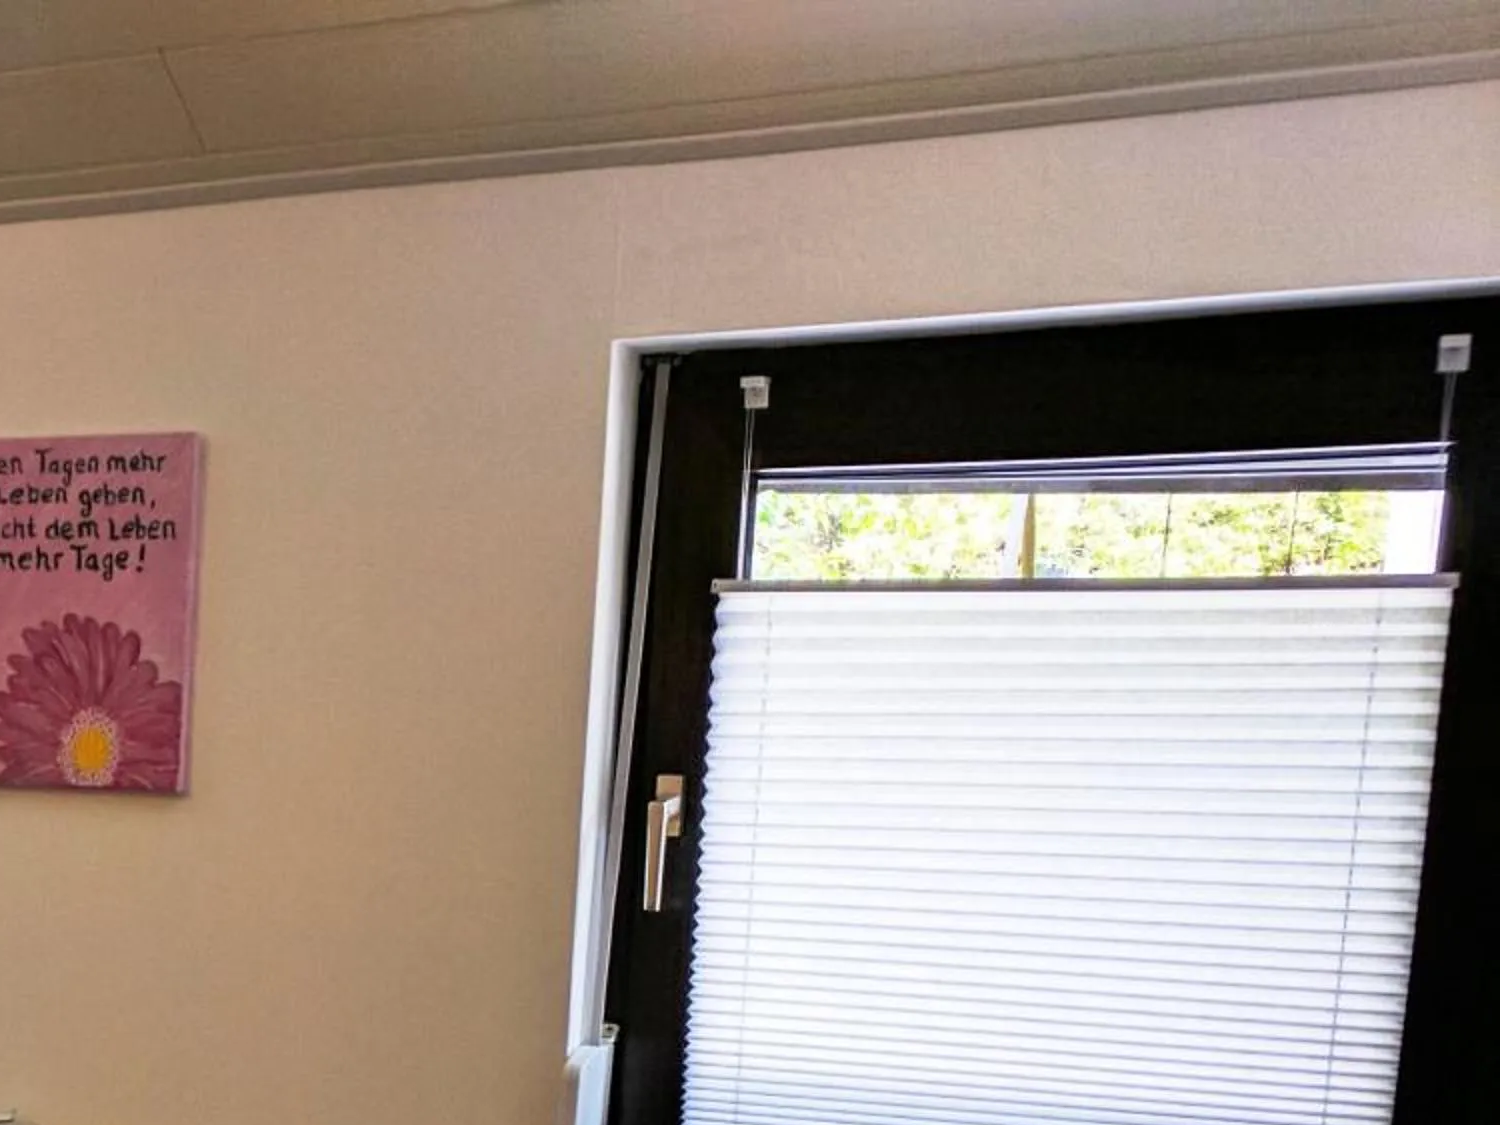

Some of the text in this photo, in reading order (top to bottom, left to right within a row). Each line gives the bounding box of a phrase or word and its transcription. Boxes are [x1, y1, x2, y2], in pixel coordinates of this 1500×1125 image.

[35, 448, 99, 486] Tagen
[106, 450, 166, 474] mehr
[79, 483, 156, 516] geben,
[45, 518, 99, 541] dem
[108, 512, 177, 541] Leben
